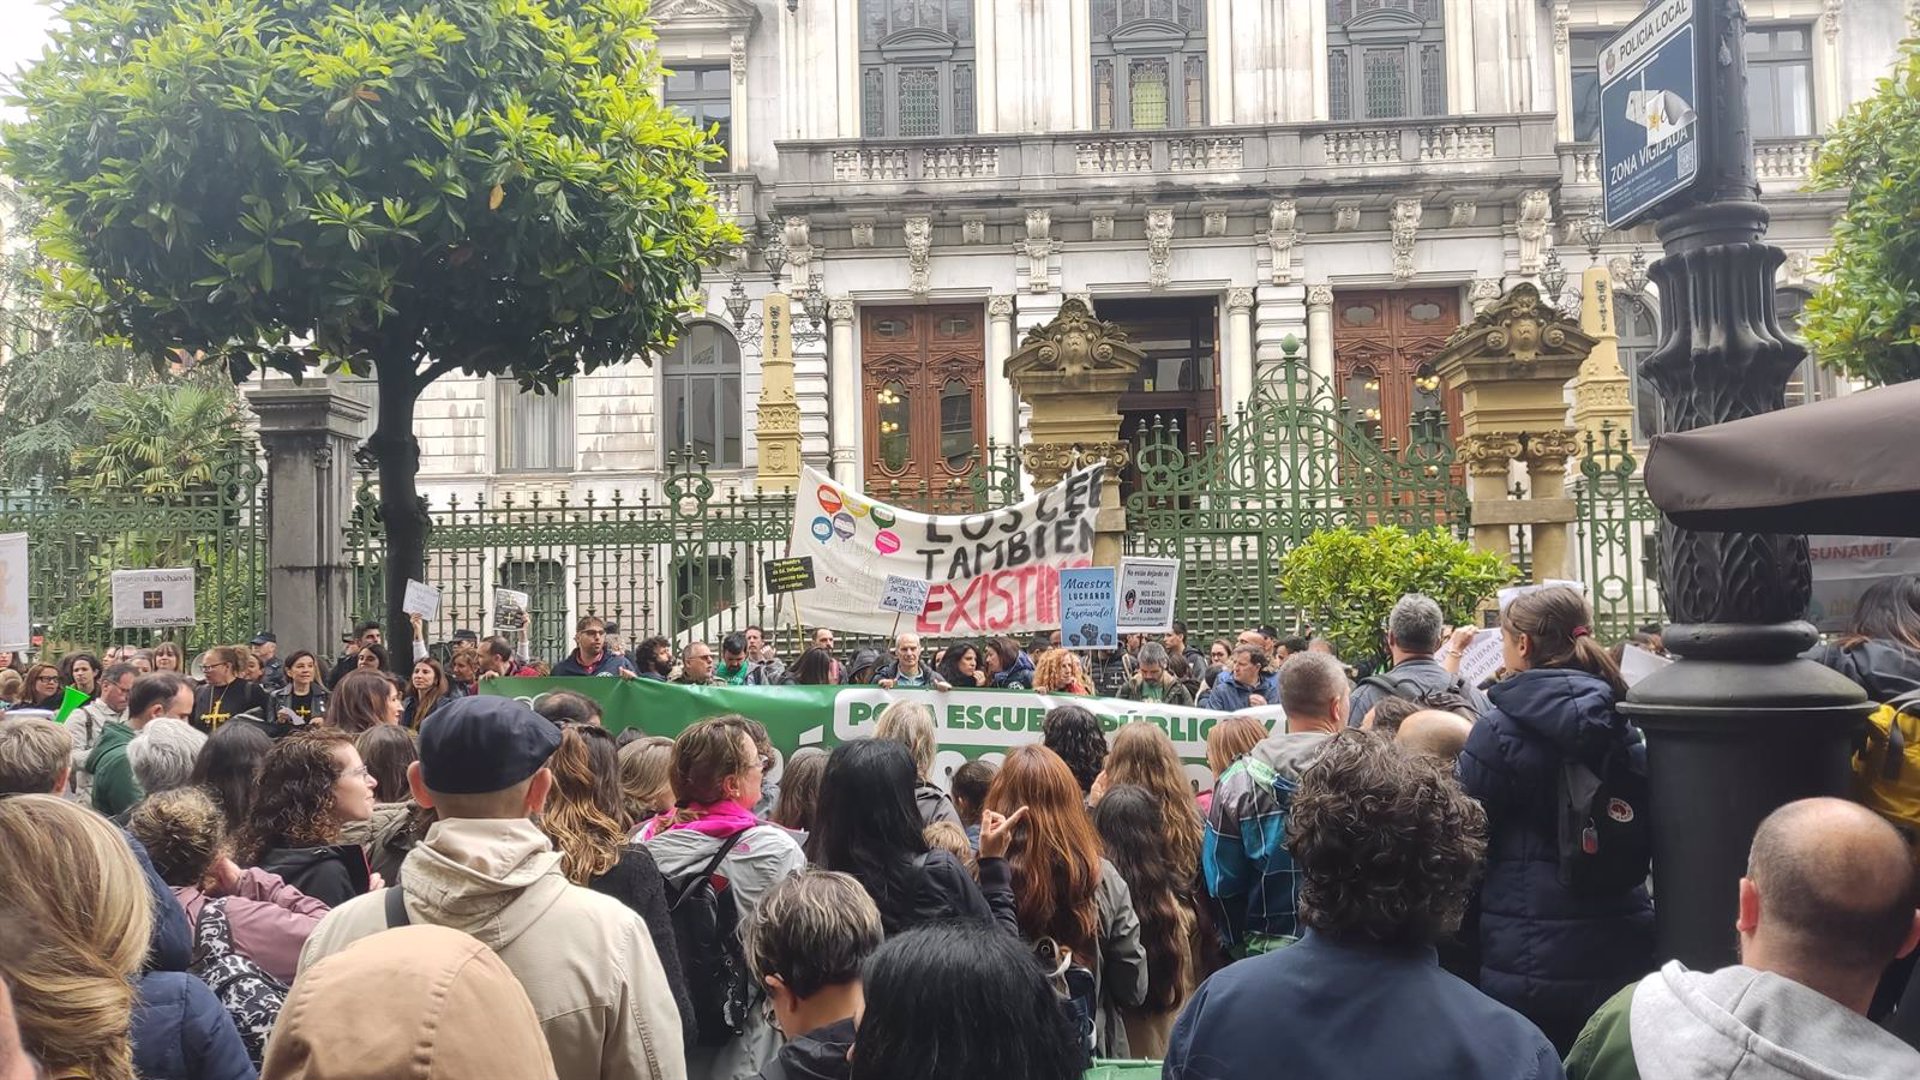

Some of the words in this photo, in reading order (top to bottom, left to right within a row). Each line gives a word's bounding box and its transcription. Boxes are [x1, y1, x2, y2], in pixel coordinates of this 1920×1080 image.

[1620, 22, 1655, 62] POLICÍA
[1655, 0, 1688, 33] LOCAL
[1610, 153, 1638, 186] ZONA
[1638, 126, 1689, 168] VIGILADA
[926, 510, 1023, 543] LOS
[1808, 542, 1892, 560] SUNAMI!
[1064, 578, 1112, 590] Maestrx
[1068, 592, 1111, 601] LUCHANDO
[947, 705, 1046, 731] ESCUE
[1095, 709, 1218, 742] PBLIC
